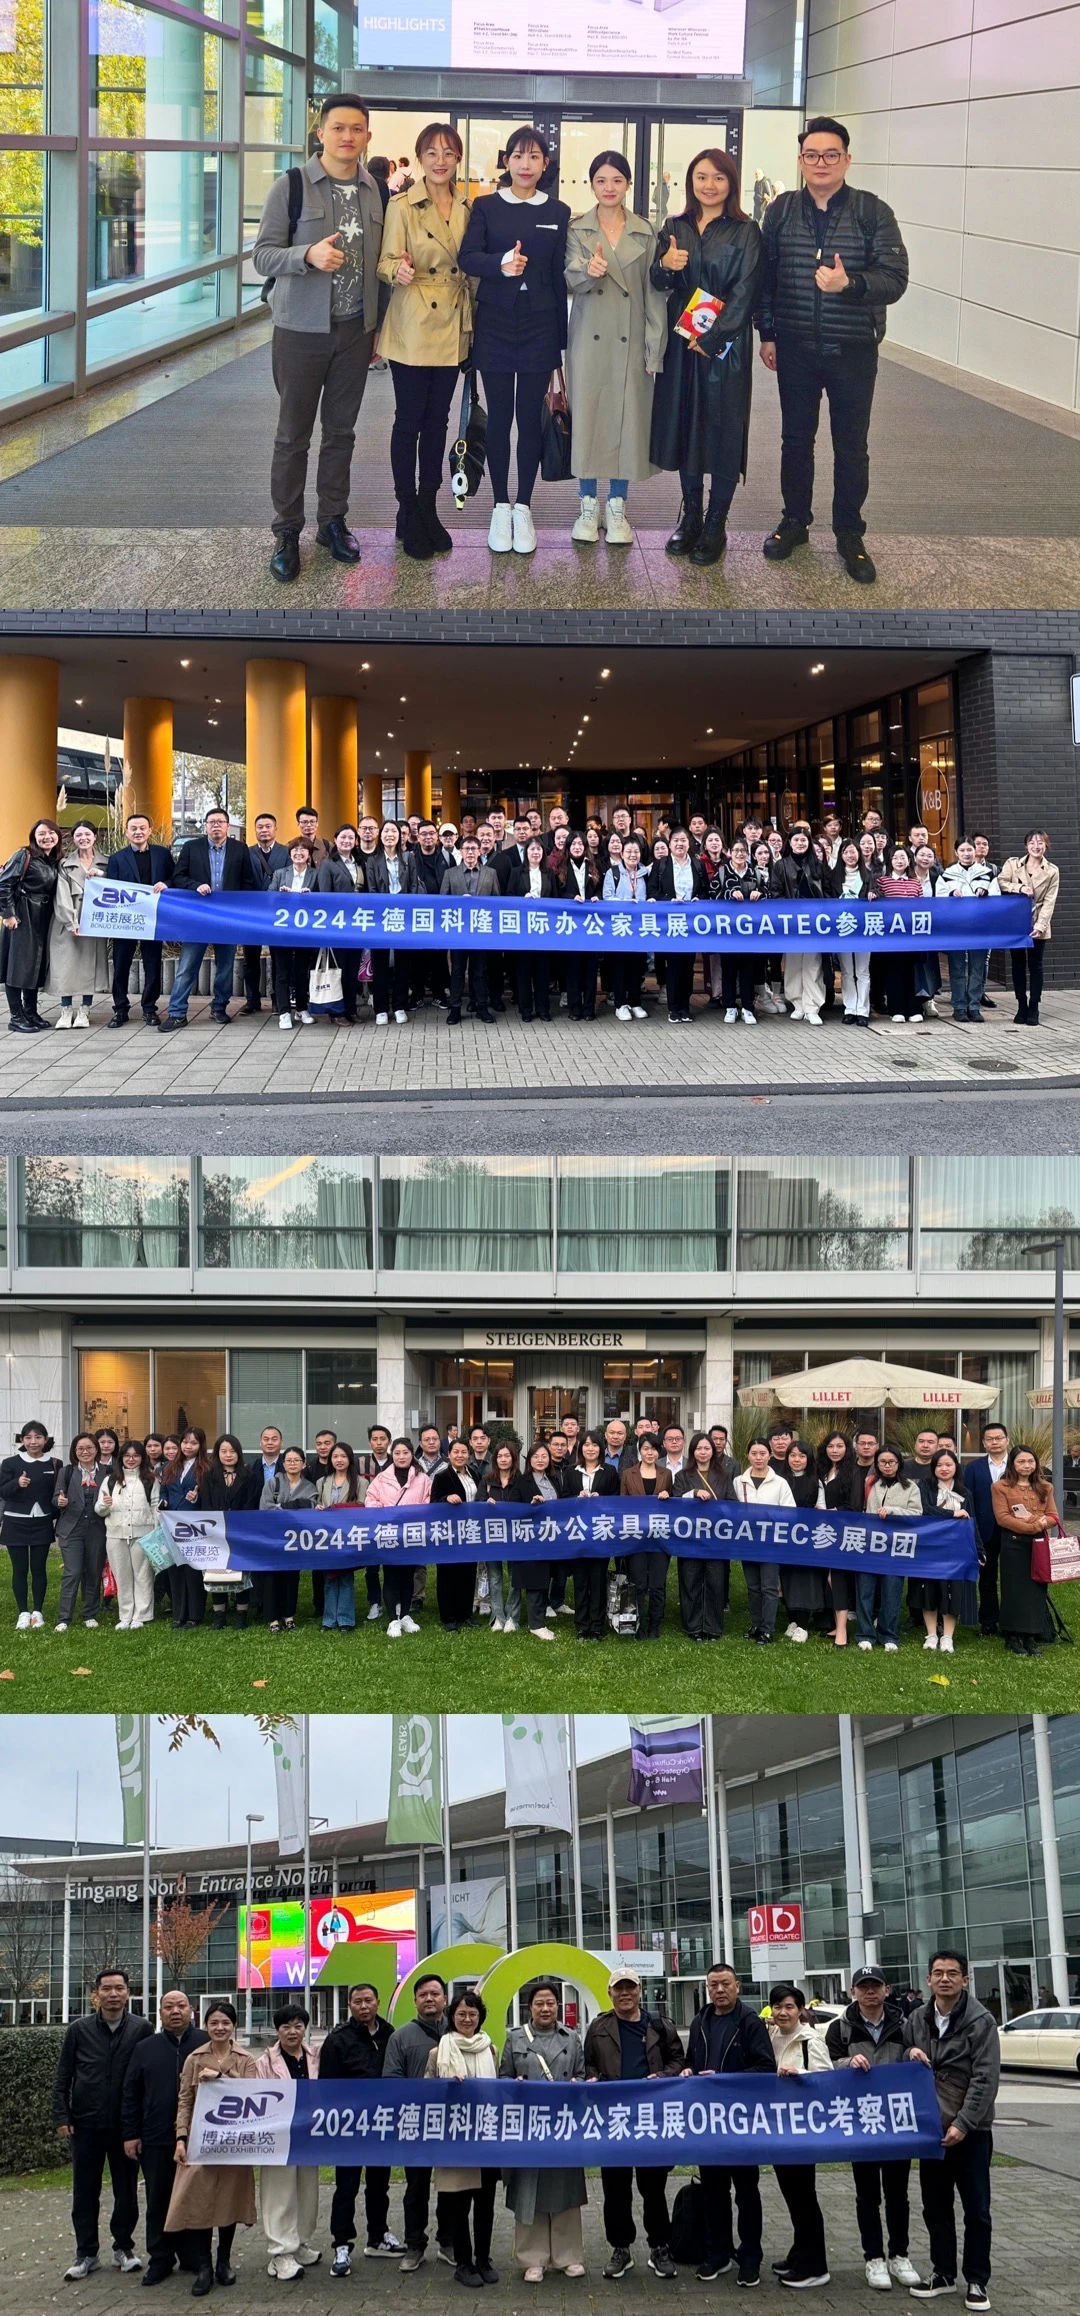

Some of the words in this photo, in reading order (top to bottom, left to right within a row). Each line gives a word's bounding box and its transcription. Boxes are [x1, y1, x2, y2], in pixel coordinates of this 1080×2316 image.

[363, 16, 446, 32] HIGHLIGHTS
[922, 790, 942, 811] K&B
[101, 887, 138, 904] BN
[92, 911, 147, 925] 博诺展览
[273, 908, 933, 937] 2024年德国科隆国际办公家具展ORGATEC参展A团
[90, 922, 112, 930] BONUO
[112, 923, 145, 931] EXHIBITION
[486, 1332, 623, 1347] STEIGENBERGER
[812, 1391, 852, 1402] LILLET
[923, 1392, 962, 1403] LILLET
[1036, 1394, 1054, 1404] LILLE
[175, 1522, 207, 1538] BN
[284, 1513, 918, 1558] 2024年德国科隆国际办公家具展ORGATEC参展B团
[180, 1545, 220, 1557] 诺展览
[66, 1883, 138, 1903] Eingang
[148, 1876, 187, 1896] Nord
[199, 1874, 273, 1893] Entrance
[443, 1892, 470, 1905] LICHT
[769, 1933, 800, 1941] ORGATEC
[217, 2096, 267, 2119] BN
[310, 2092, 919, 2142] 2024年德国科隆国际办公家具展ORGATEC考察团
[201, 2130, 276, 2146] 博诺展览
[200, 2146, 229, 2154] BONUO
[230, 2146, 275, 2154] EXHIBITION
